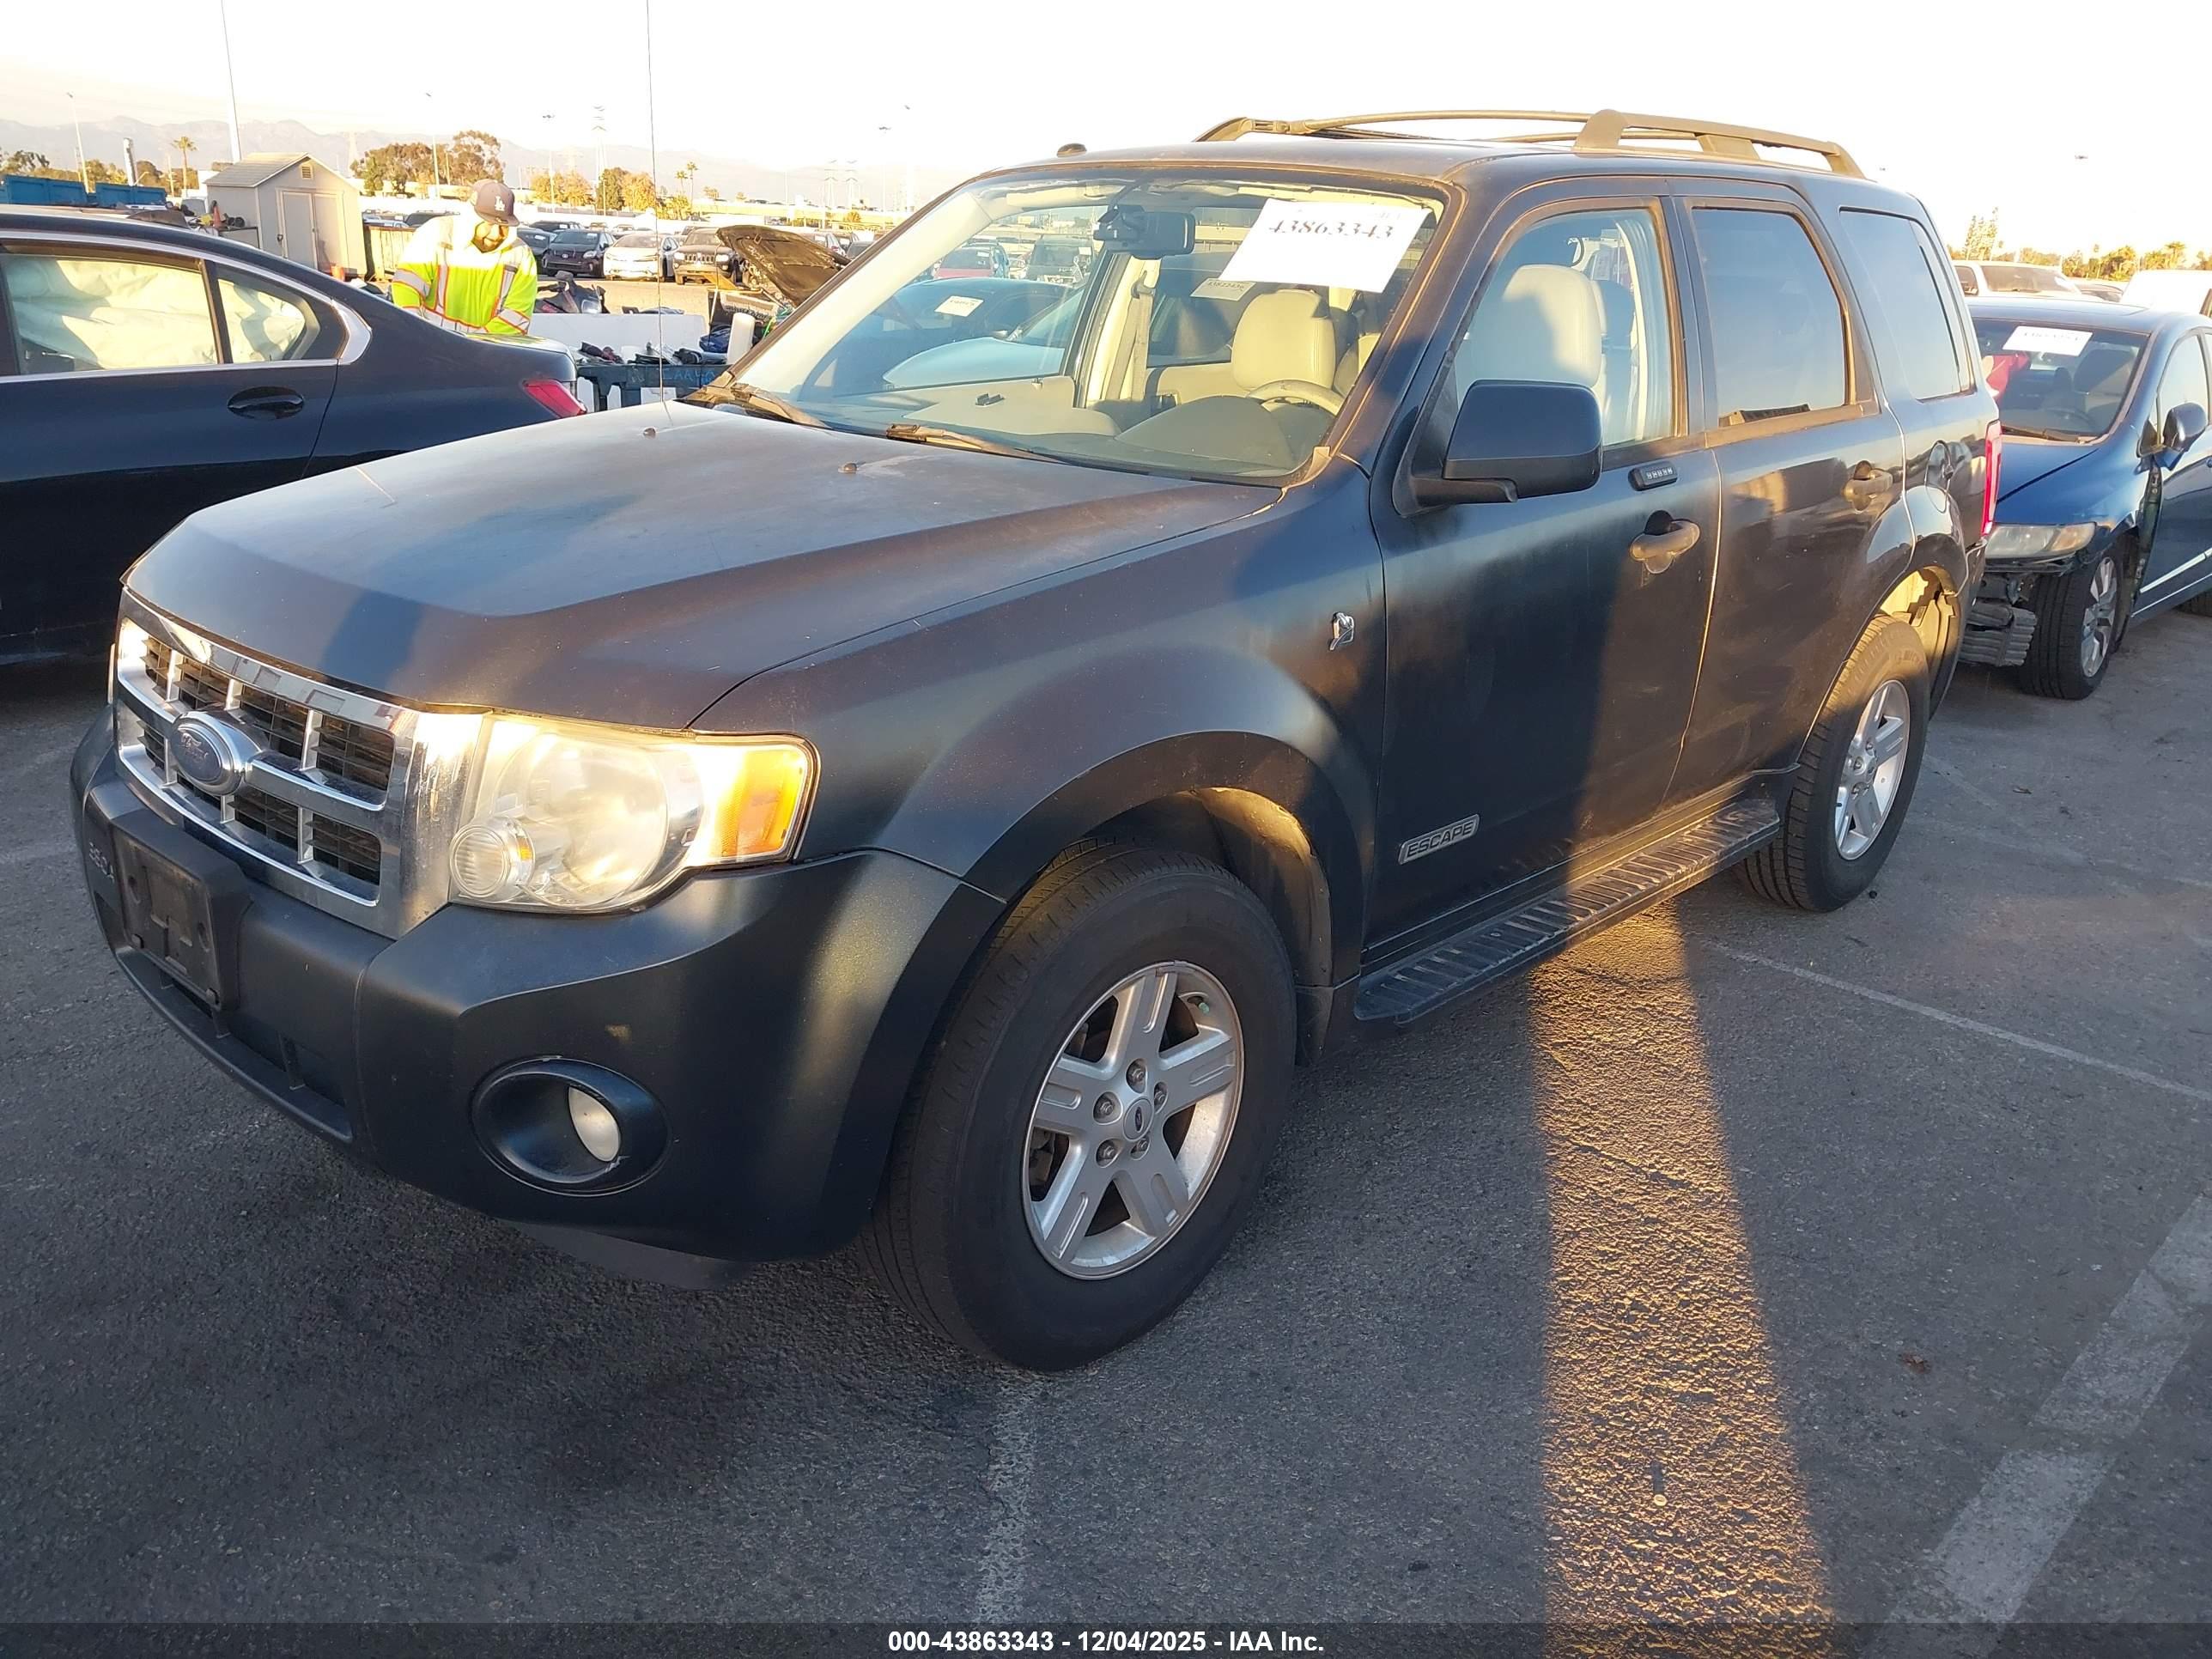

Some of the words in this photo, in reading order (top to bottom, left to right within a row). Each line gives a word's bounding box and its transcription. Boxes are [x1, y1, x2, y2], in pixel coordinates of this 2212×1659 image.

[495, 196, 505, 211] LA
[1268, 220, 1394, 239] 43863343
[1406, 820, 1475, 858] ESCAPE
